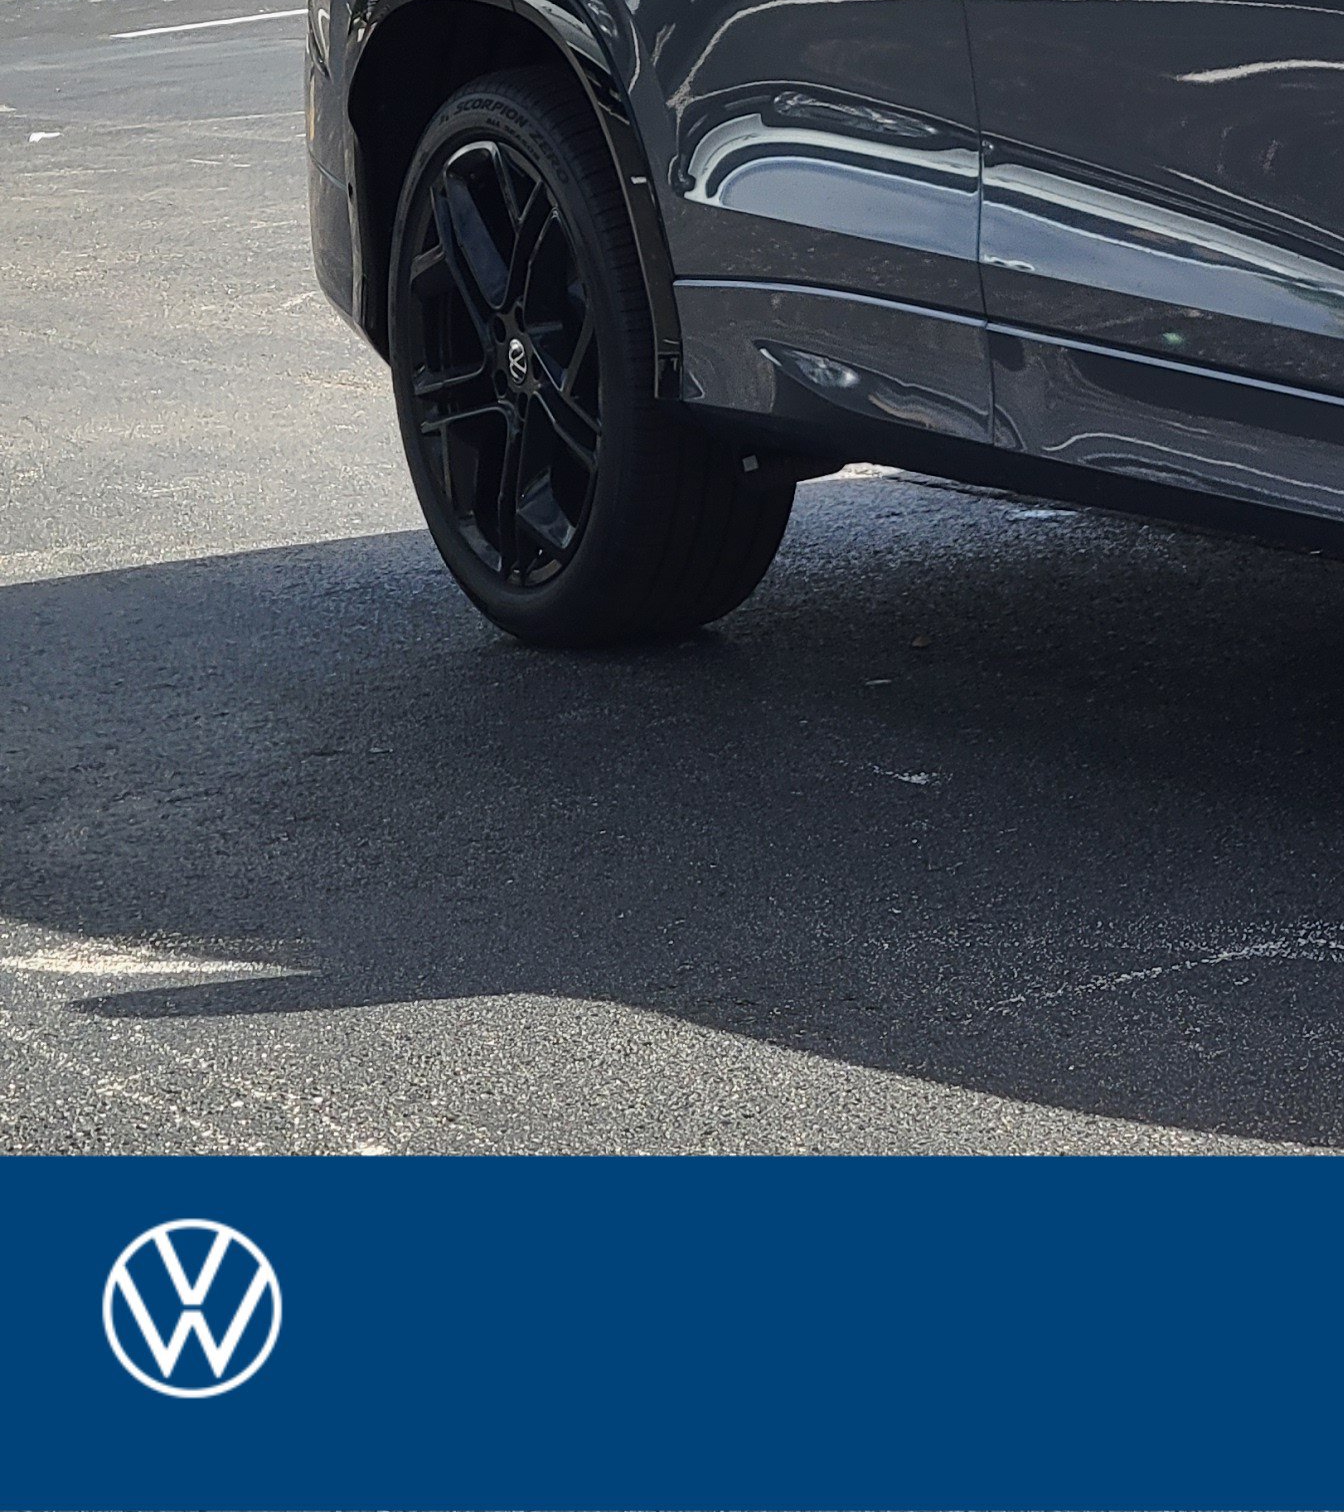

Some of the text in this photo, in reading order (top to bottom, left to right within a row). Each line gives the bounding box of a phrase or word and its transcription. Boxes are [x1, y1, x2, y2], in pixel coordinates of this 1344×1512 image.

[454, 98, 569, 184] SCORPION ZERO
[486, 117, 501, 127] ALL
